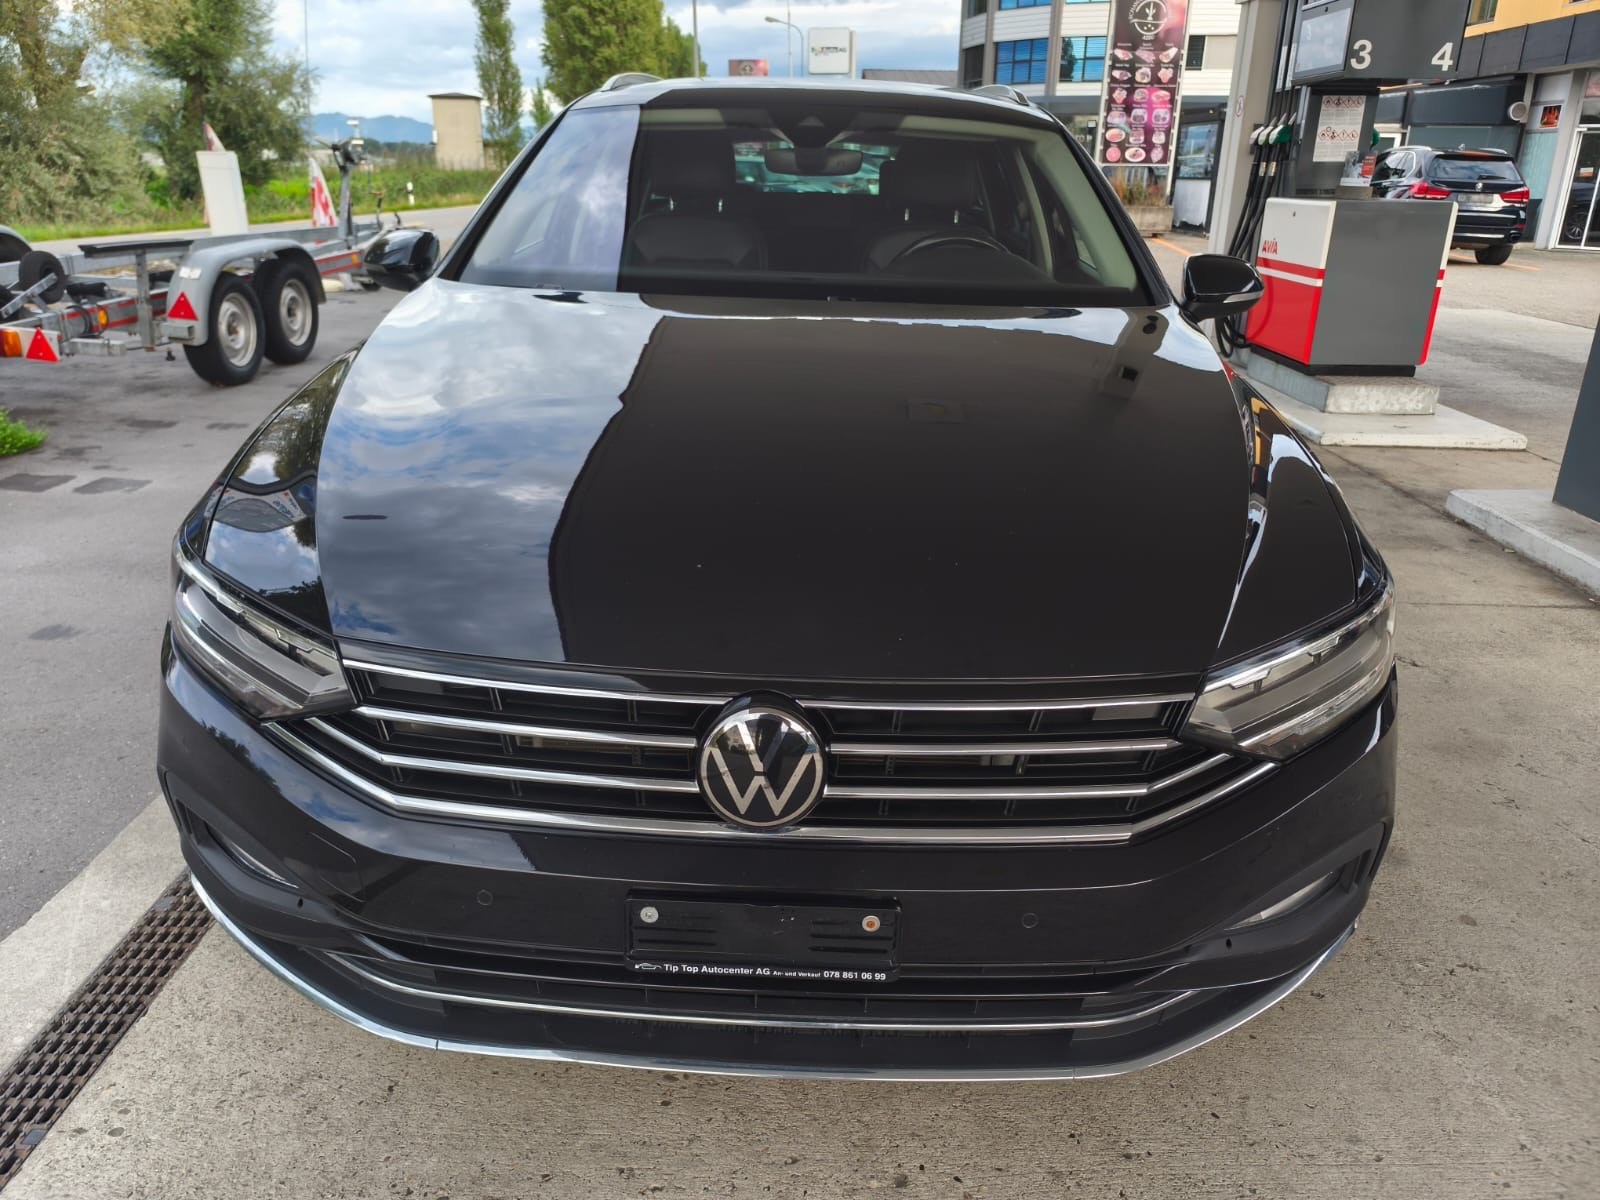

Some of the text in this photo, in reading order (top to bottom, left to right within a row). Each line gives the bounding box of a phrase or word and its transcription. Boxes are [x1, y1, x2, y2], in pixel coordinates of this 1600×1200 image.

[1350, 39, 1373, 70] 3
[1431, 42, 1454, 71] 4
[663, 963, 679, 973] Tip
[681, 964, 699, 974] Top
[701, 965, 754, 975] Autocenter
[756, 967, 771, 976] AG
[823, 970, 840, 978] 078
[842, 971, 858, 979] 861
[861, 972, 873, 980] 06
[874, 972, 886, 981] 99
